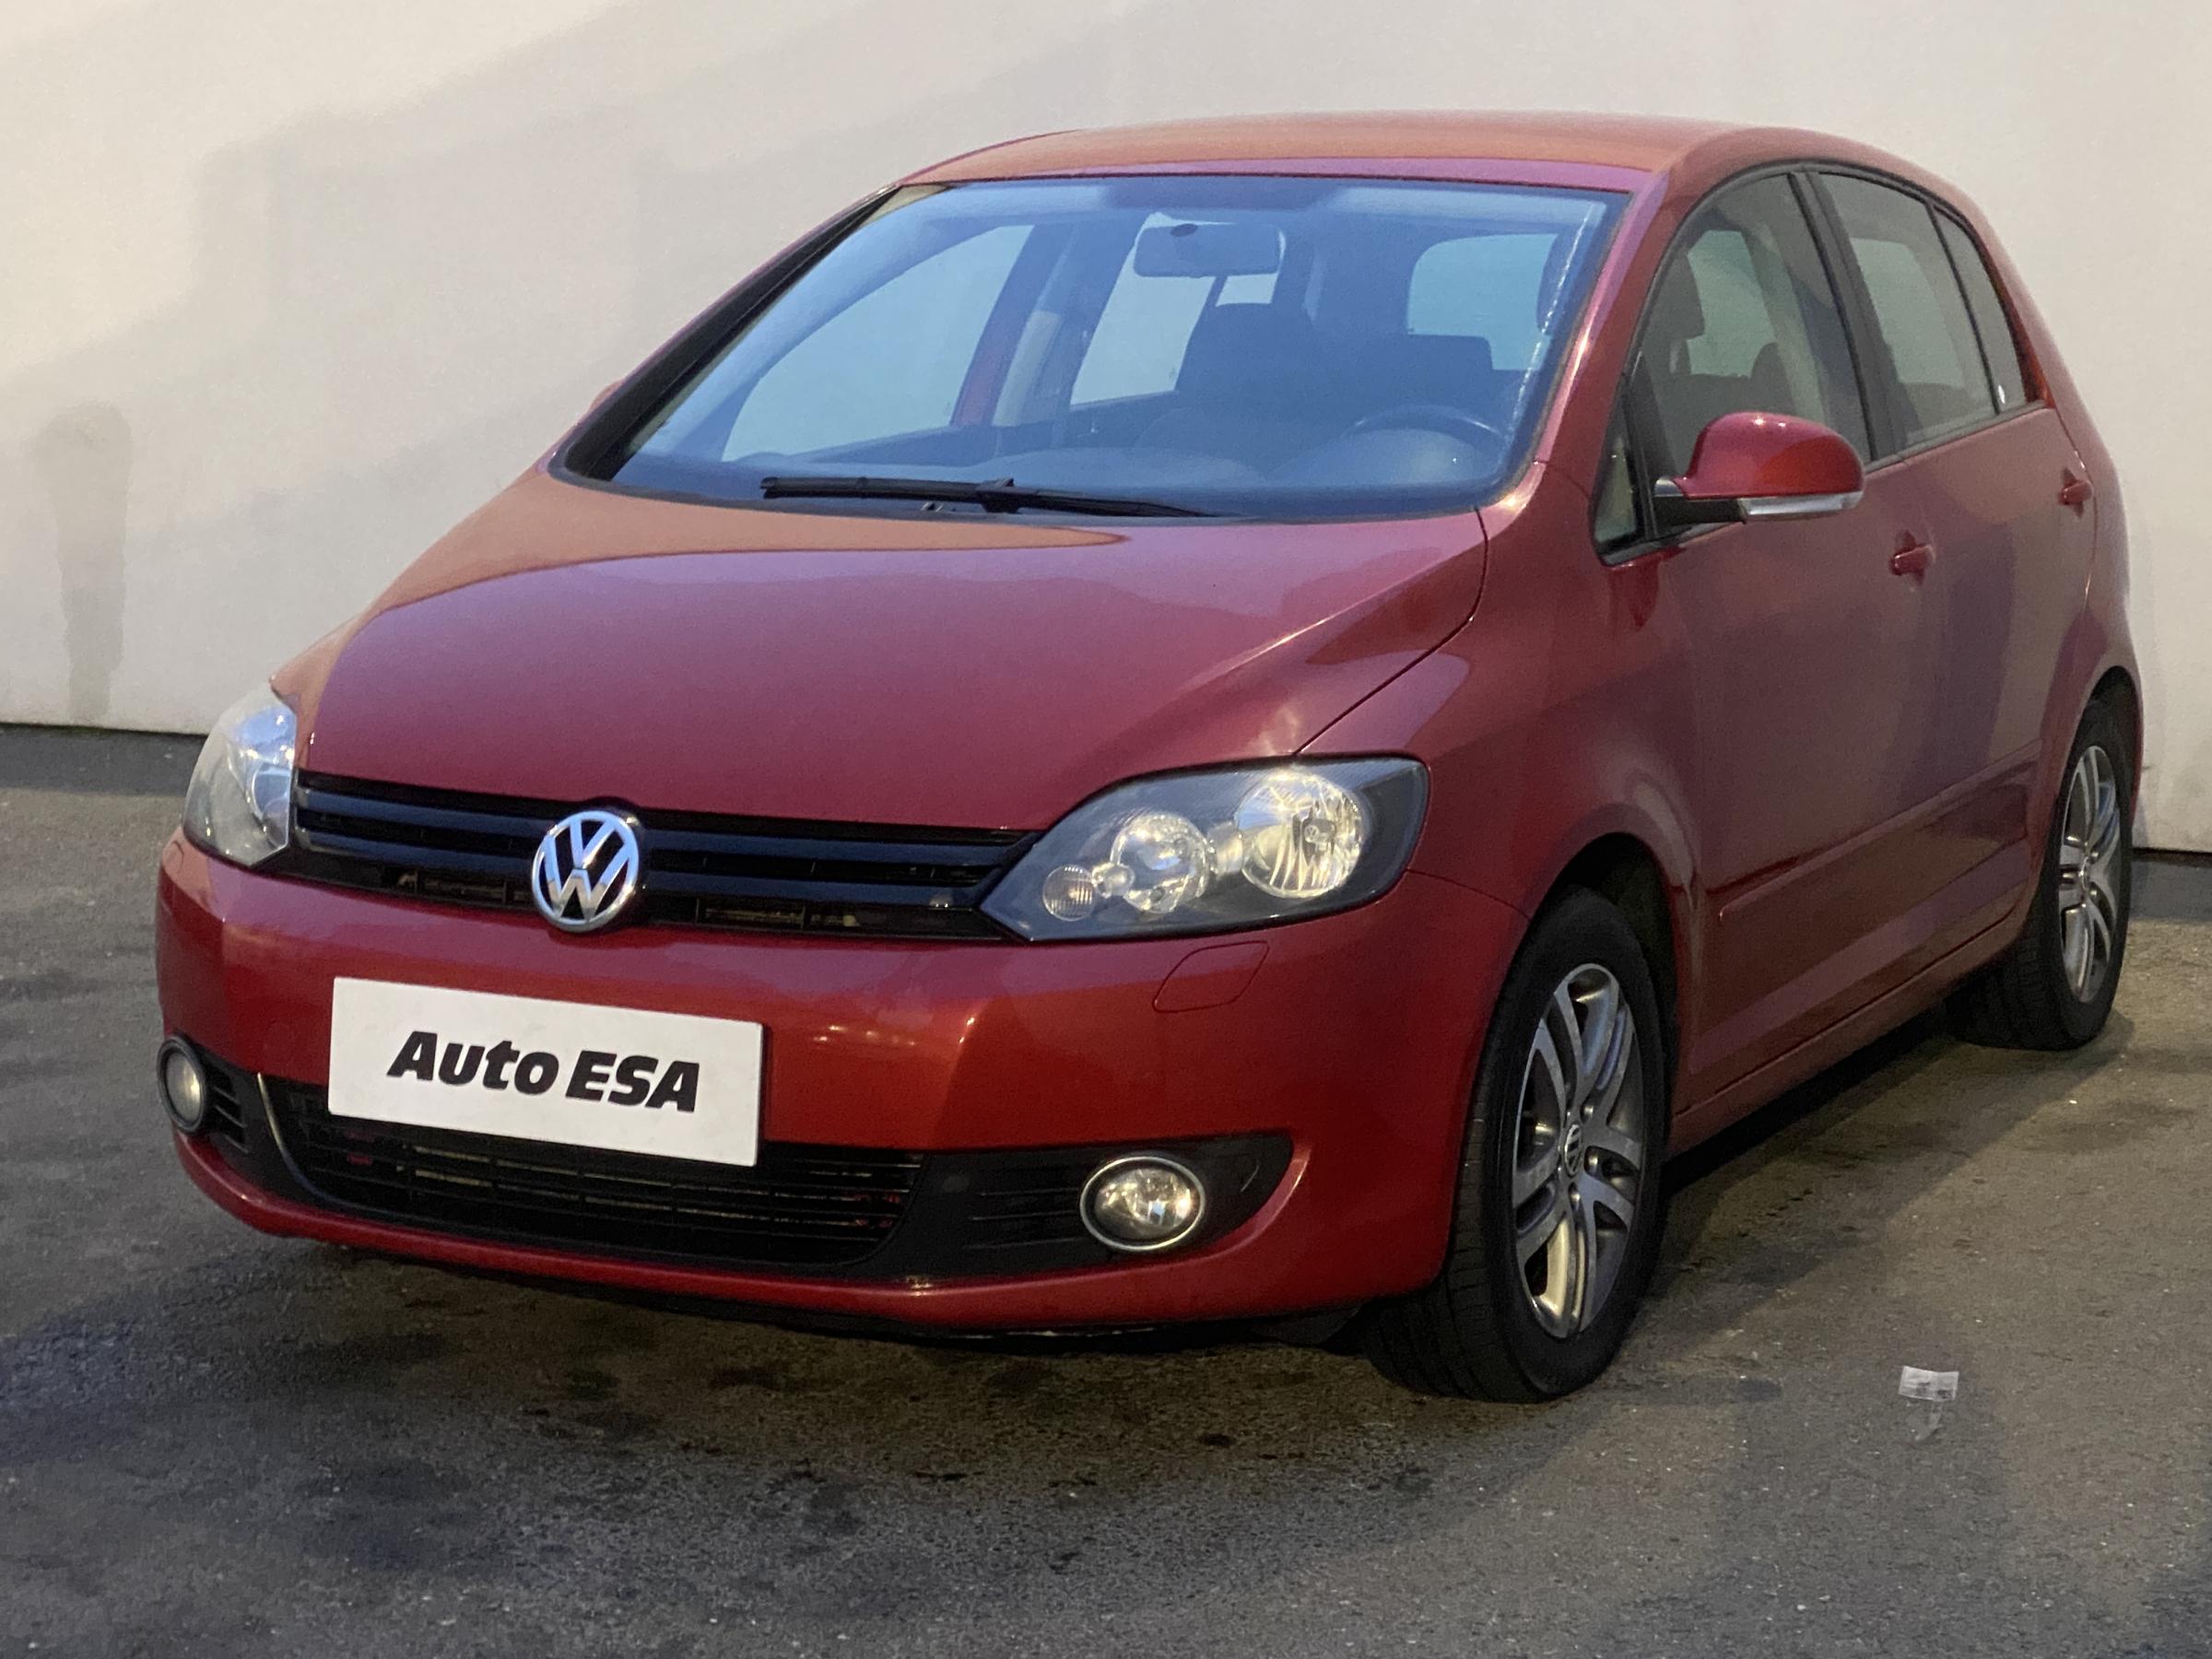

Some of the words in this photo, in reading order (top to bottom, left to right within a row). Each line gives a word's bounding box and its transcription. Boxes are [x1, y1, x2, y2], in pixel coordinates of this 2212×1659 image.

[537, 813, 635, 925] VW
[386, 1030, 559, 1096] Auto
[565, 1050, 700, 1113] ESA
